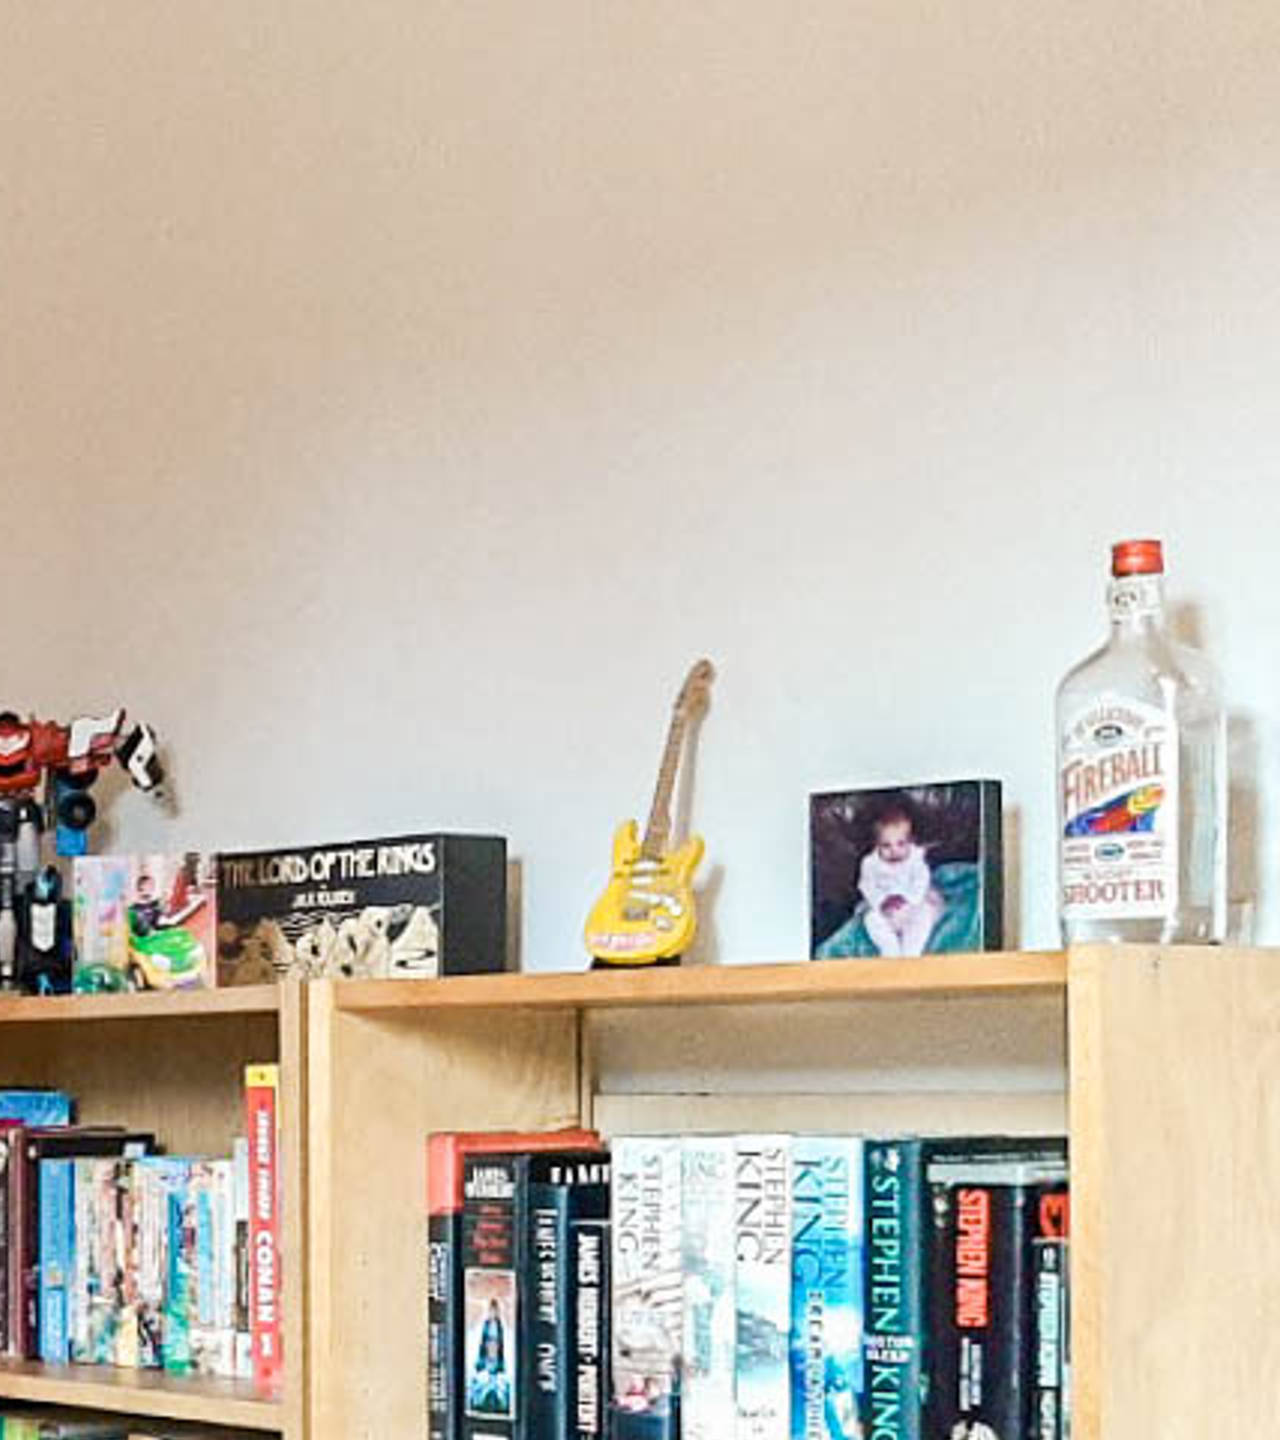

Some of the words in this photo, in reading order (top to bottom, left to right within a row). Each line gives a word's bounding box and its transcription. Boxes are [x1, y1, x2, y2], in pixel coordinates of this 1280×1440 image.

[259, 853, 308, 884] LORD
[310, 850, 337, 880] OF
[337, 848, 376, 878] THE
[376, 842, 436, 875] RINGS
[617, 1172, 640, 1254] KING
[643, 1153, 662, 1270] STEPHEN
[737, 1150, 762, 1263] KING
[763, 1147, 785, 1266] STEPHEN
[793, 1158, 823, 1288] KING
[823, 1155, 849, 1291] STEPHEN
[958, 1187, 989, 1276] STEPHEN
[254, 1229, 278, 1321] CONAN
[577, 1233, 600, 1286] JAMES
[872, 1174, 901, 1333] STEPHEN
[577, 1287, 599, 1358] HERBERT
[956, 1277, 988, 1328] KING
